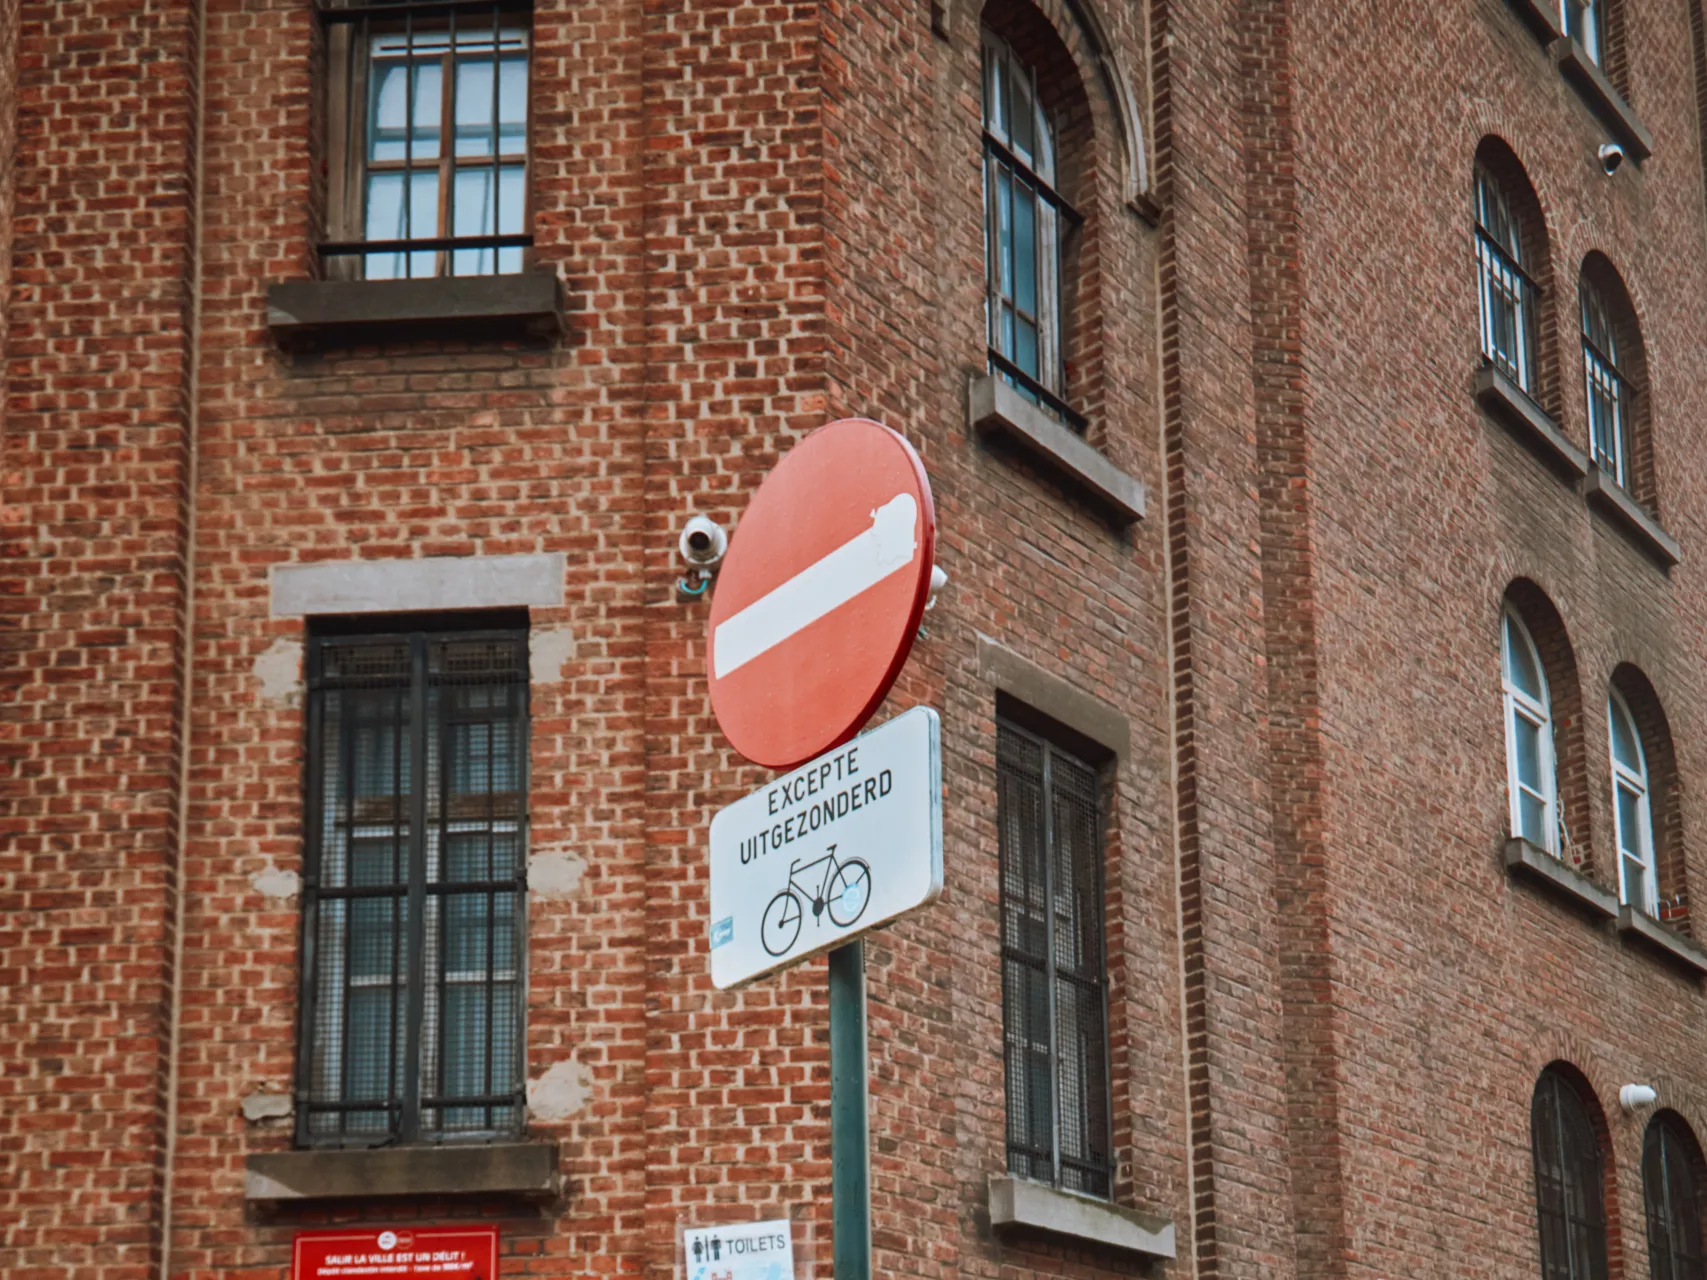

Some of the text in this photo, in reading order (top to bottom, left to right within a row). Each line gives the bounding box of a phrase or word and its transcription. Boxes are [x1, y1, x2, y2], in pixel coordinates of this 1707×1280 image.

[768, 746, 859, 816] EXCEPTE
[740, 769, 892, 865] UITGEZONDERD
[325, 1254, 352, 1266] SALIR
[354, 1254, 366, 1265] LA
[368, 1253, 394, 1264] VILLE
[396, 1252, 413, 1263] EST
[415, 1252, 431, 1262] UN
[726, 1234, 786, 1255] TOILETS
